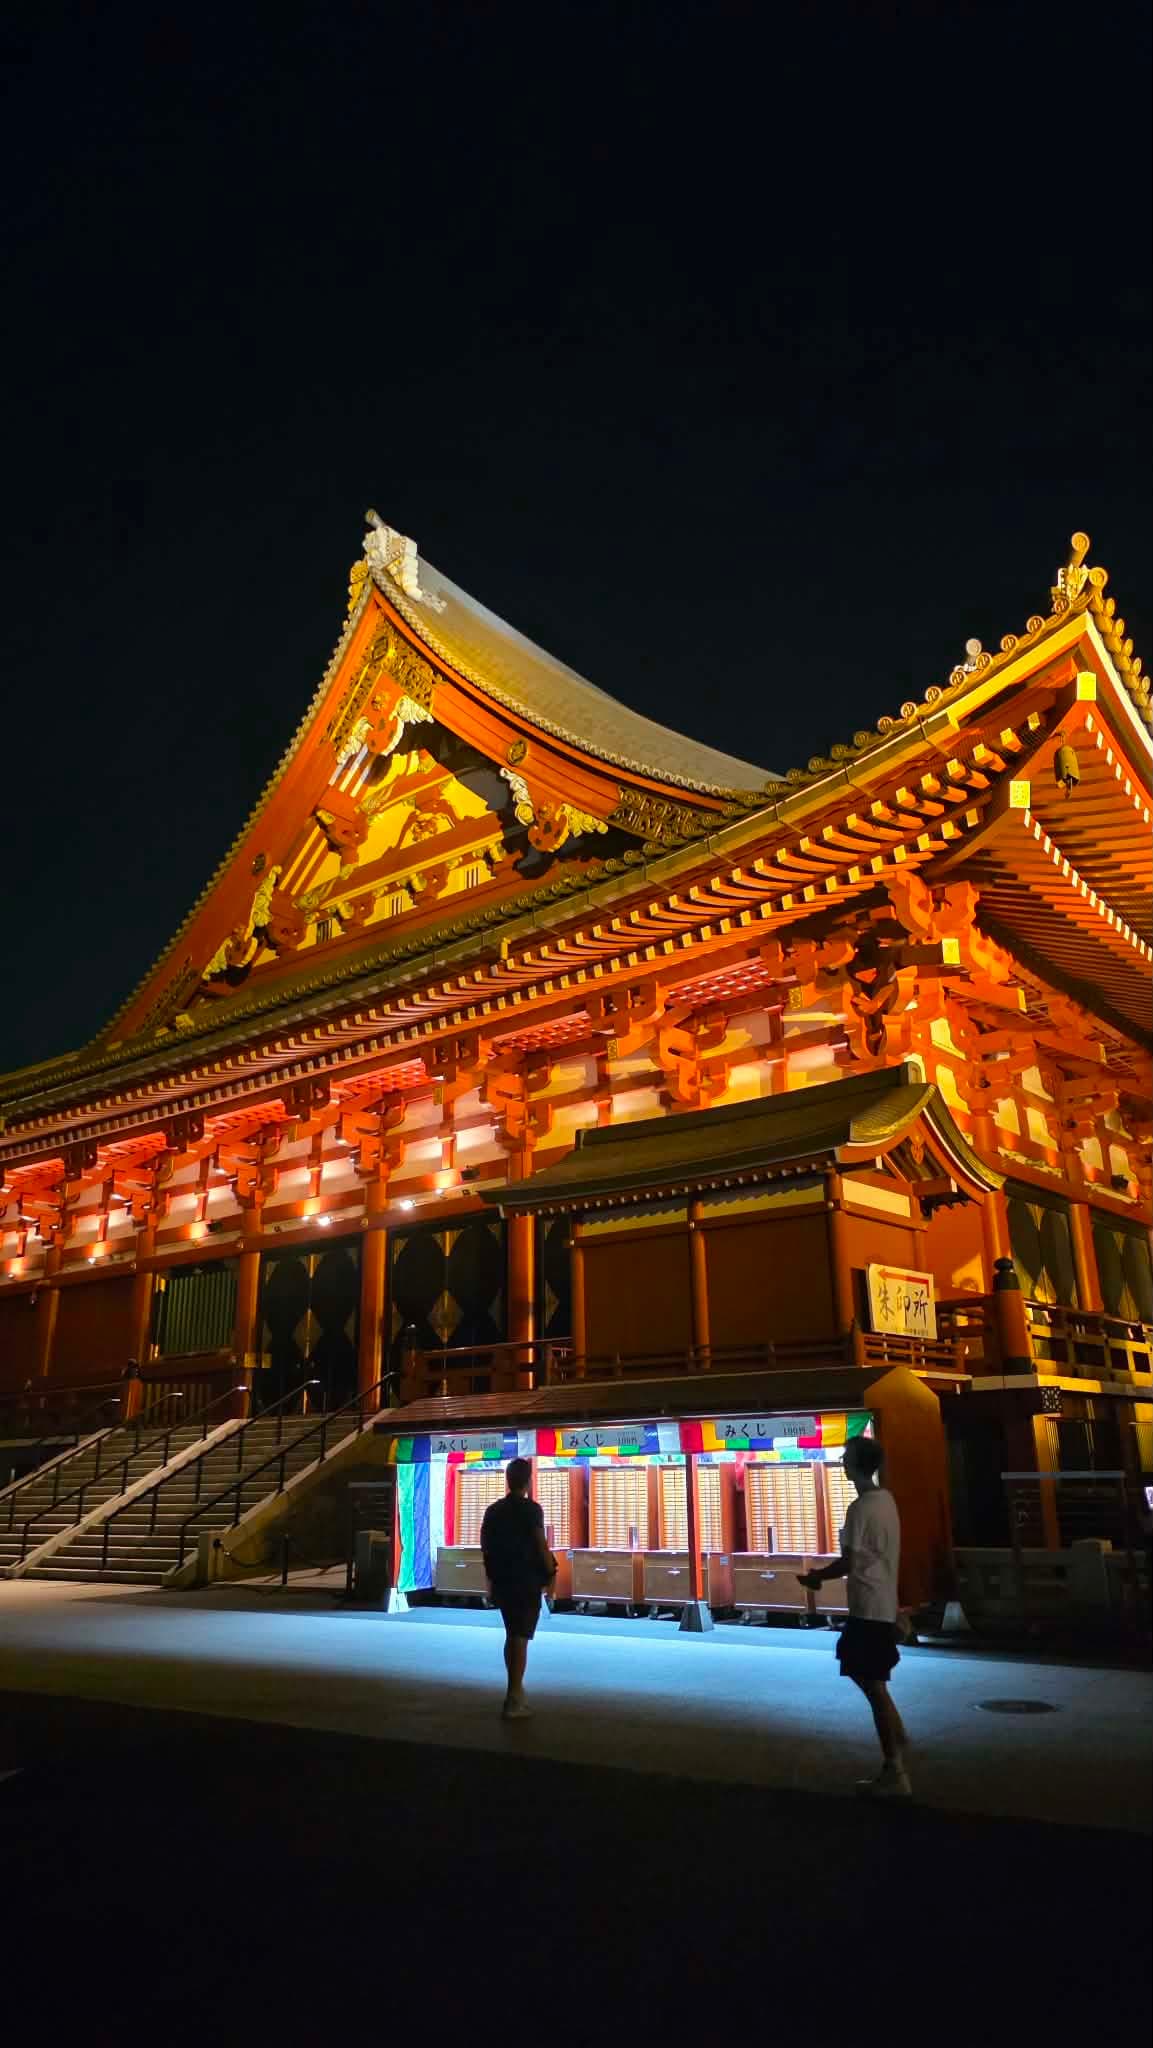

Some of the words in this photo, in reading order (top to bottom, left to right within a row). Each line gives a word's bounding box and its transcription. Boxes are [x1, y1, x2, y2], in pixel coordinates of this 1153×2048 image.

[725, 1423, 766, 1438] みくじ
[438, 1440, 469, 1451] みくじ
[569, 1433, 605, 1448] みくじ
